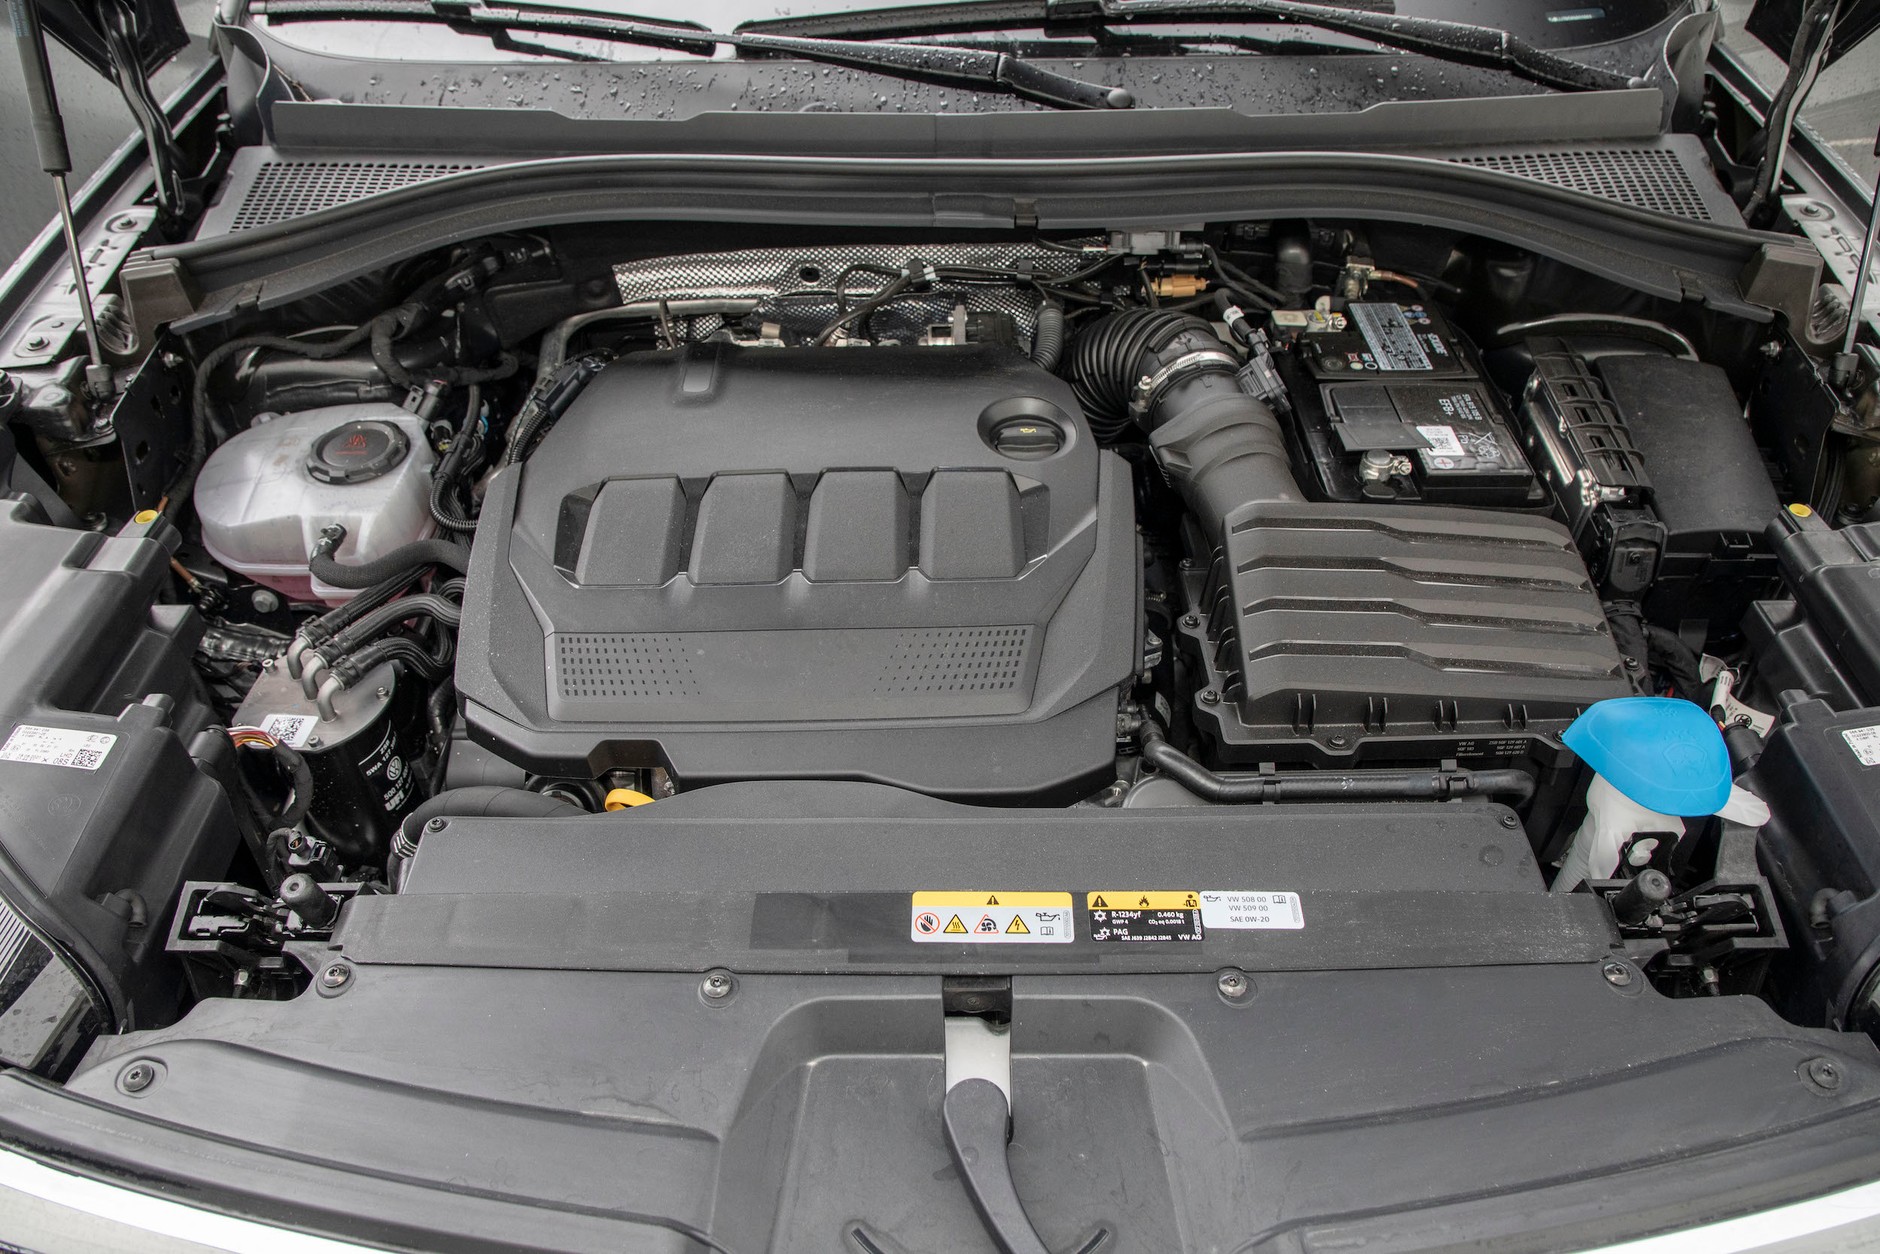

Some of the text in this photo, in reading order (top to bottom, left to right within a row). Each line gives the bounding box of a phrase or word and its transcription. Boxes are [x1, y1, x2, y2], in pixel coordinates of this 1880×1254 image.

[1438, 398, 1454, 416] EFB+
[366, 748, 391, 777] 5WA 127
[384, 790, 405, 811] UFI
[1111, 911, 1141, 919] R-1234yf
[1176, 911, 1184, 919] kg
